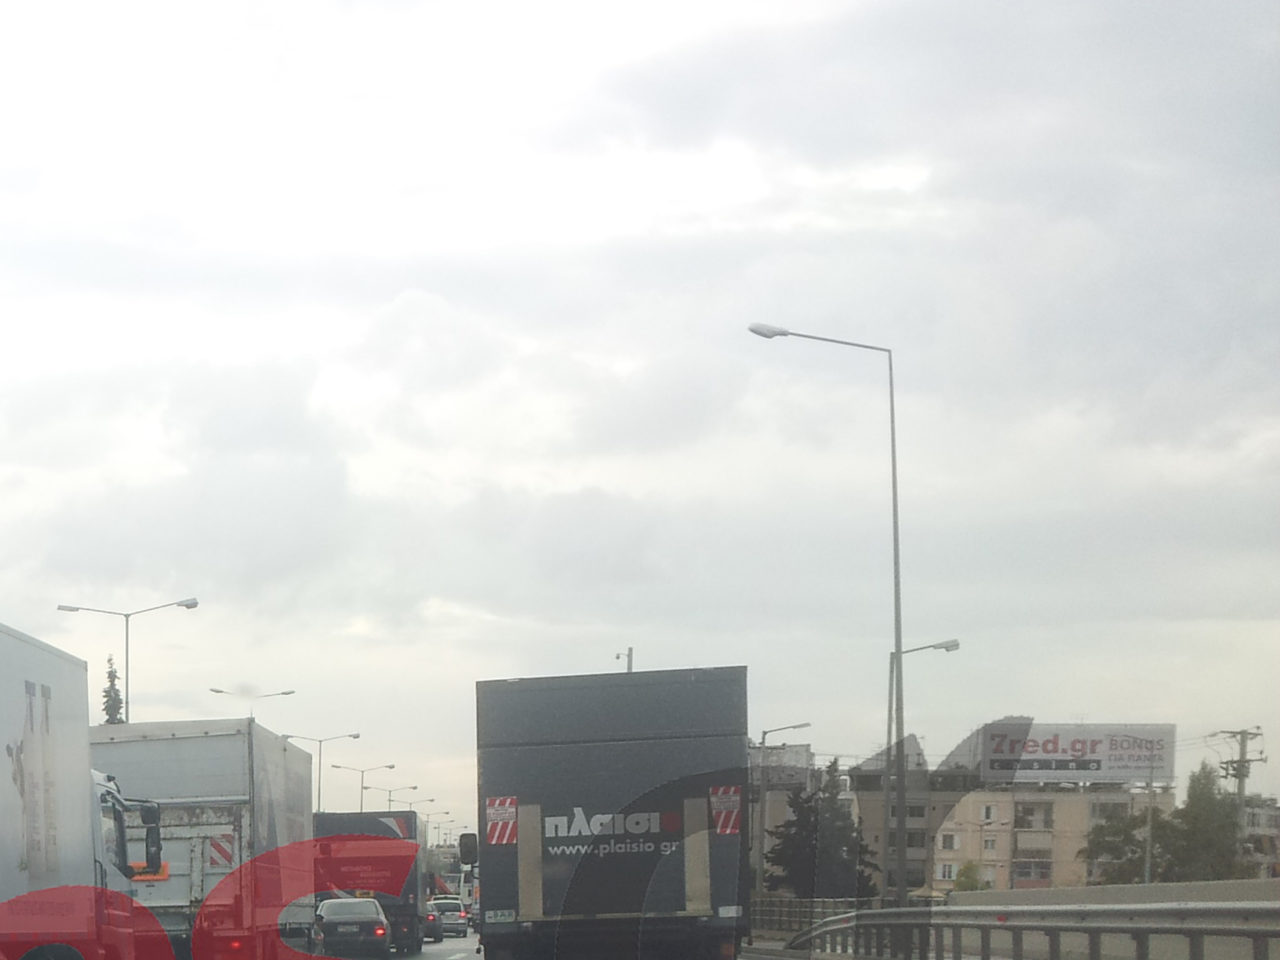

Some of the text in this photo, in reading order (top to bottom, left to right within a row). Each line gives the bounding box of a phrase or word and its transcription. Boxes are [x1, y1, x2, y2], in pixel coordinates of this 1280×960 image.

[990, 732, 1102, 760] 7red.gr
[1109, 738, 1165, 751] BONUS
[993, 762, 1097, 770] casino
